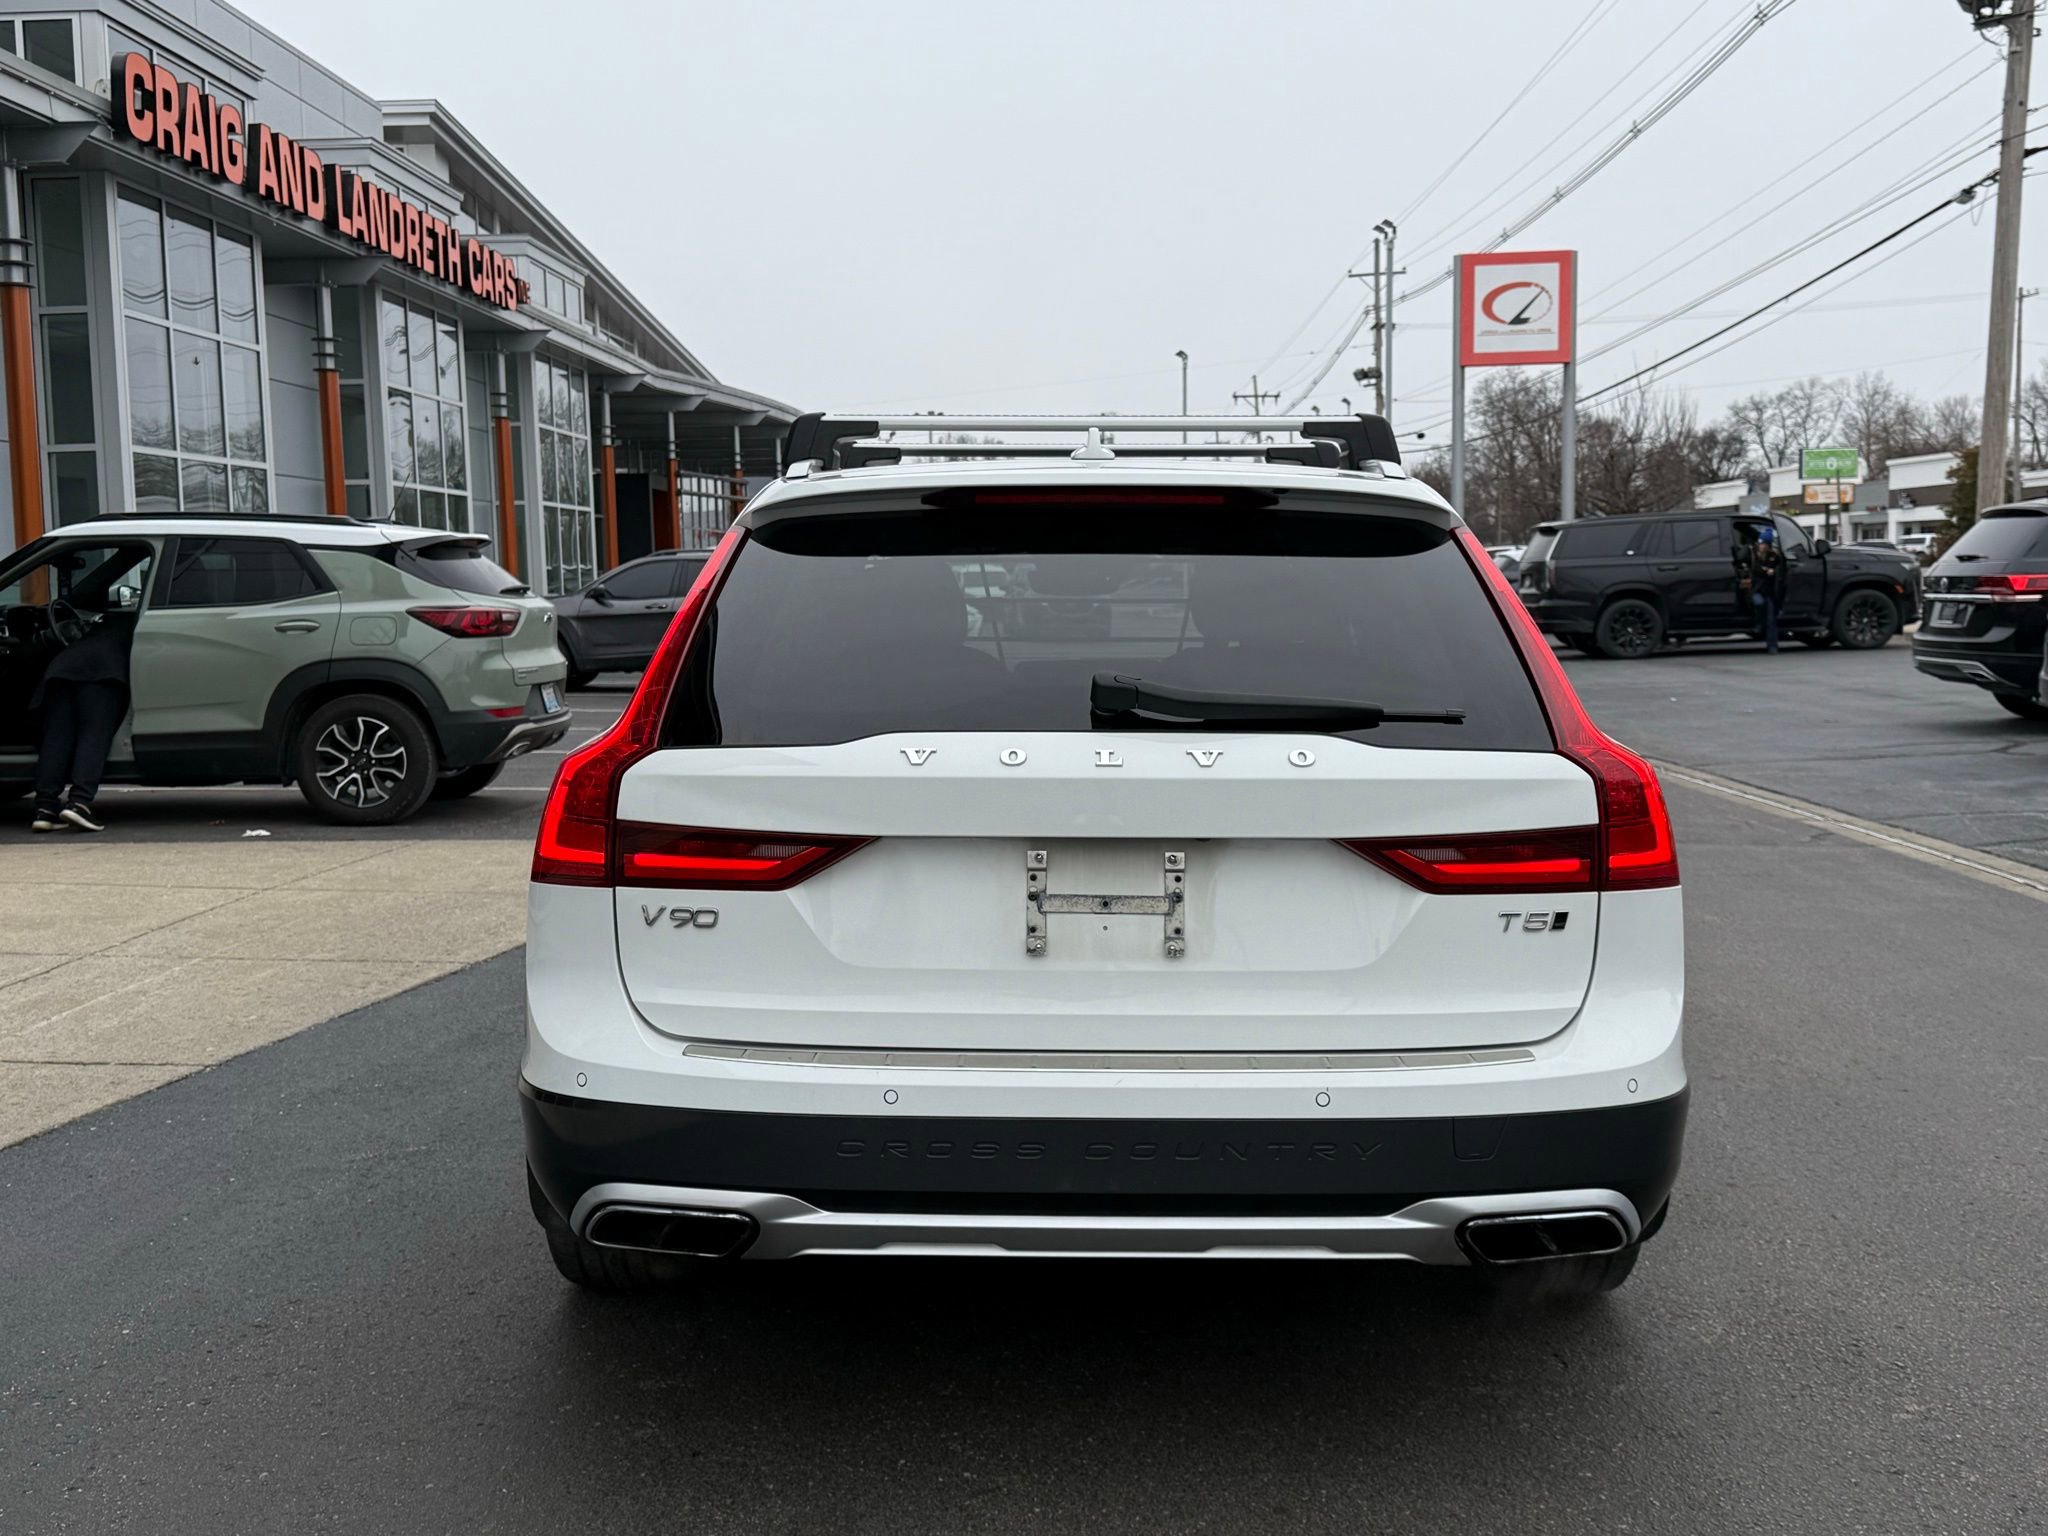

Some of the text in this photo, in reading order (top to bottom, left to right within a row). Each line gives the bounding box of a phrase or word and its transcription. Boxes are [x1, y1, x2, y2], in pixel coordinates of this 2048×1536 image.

[122, 51, 245, 186] CRAIG
[256, 122, 326, 221] AND
[335, 163, 463, 288] LANDRETH
[467, 237, 518, 312] CARS
[899, 747, 1317, 768] VOLVO
[641, 904, 720, 929] V90
[1498, 911, 1550, 933] T5
[836, 1141, 1385, 1161] CROSS COUNTRY
